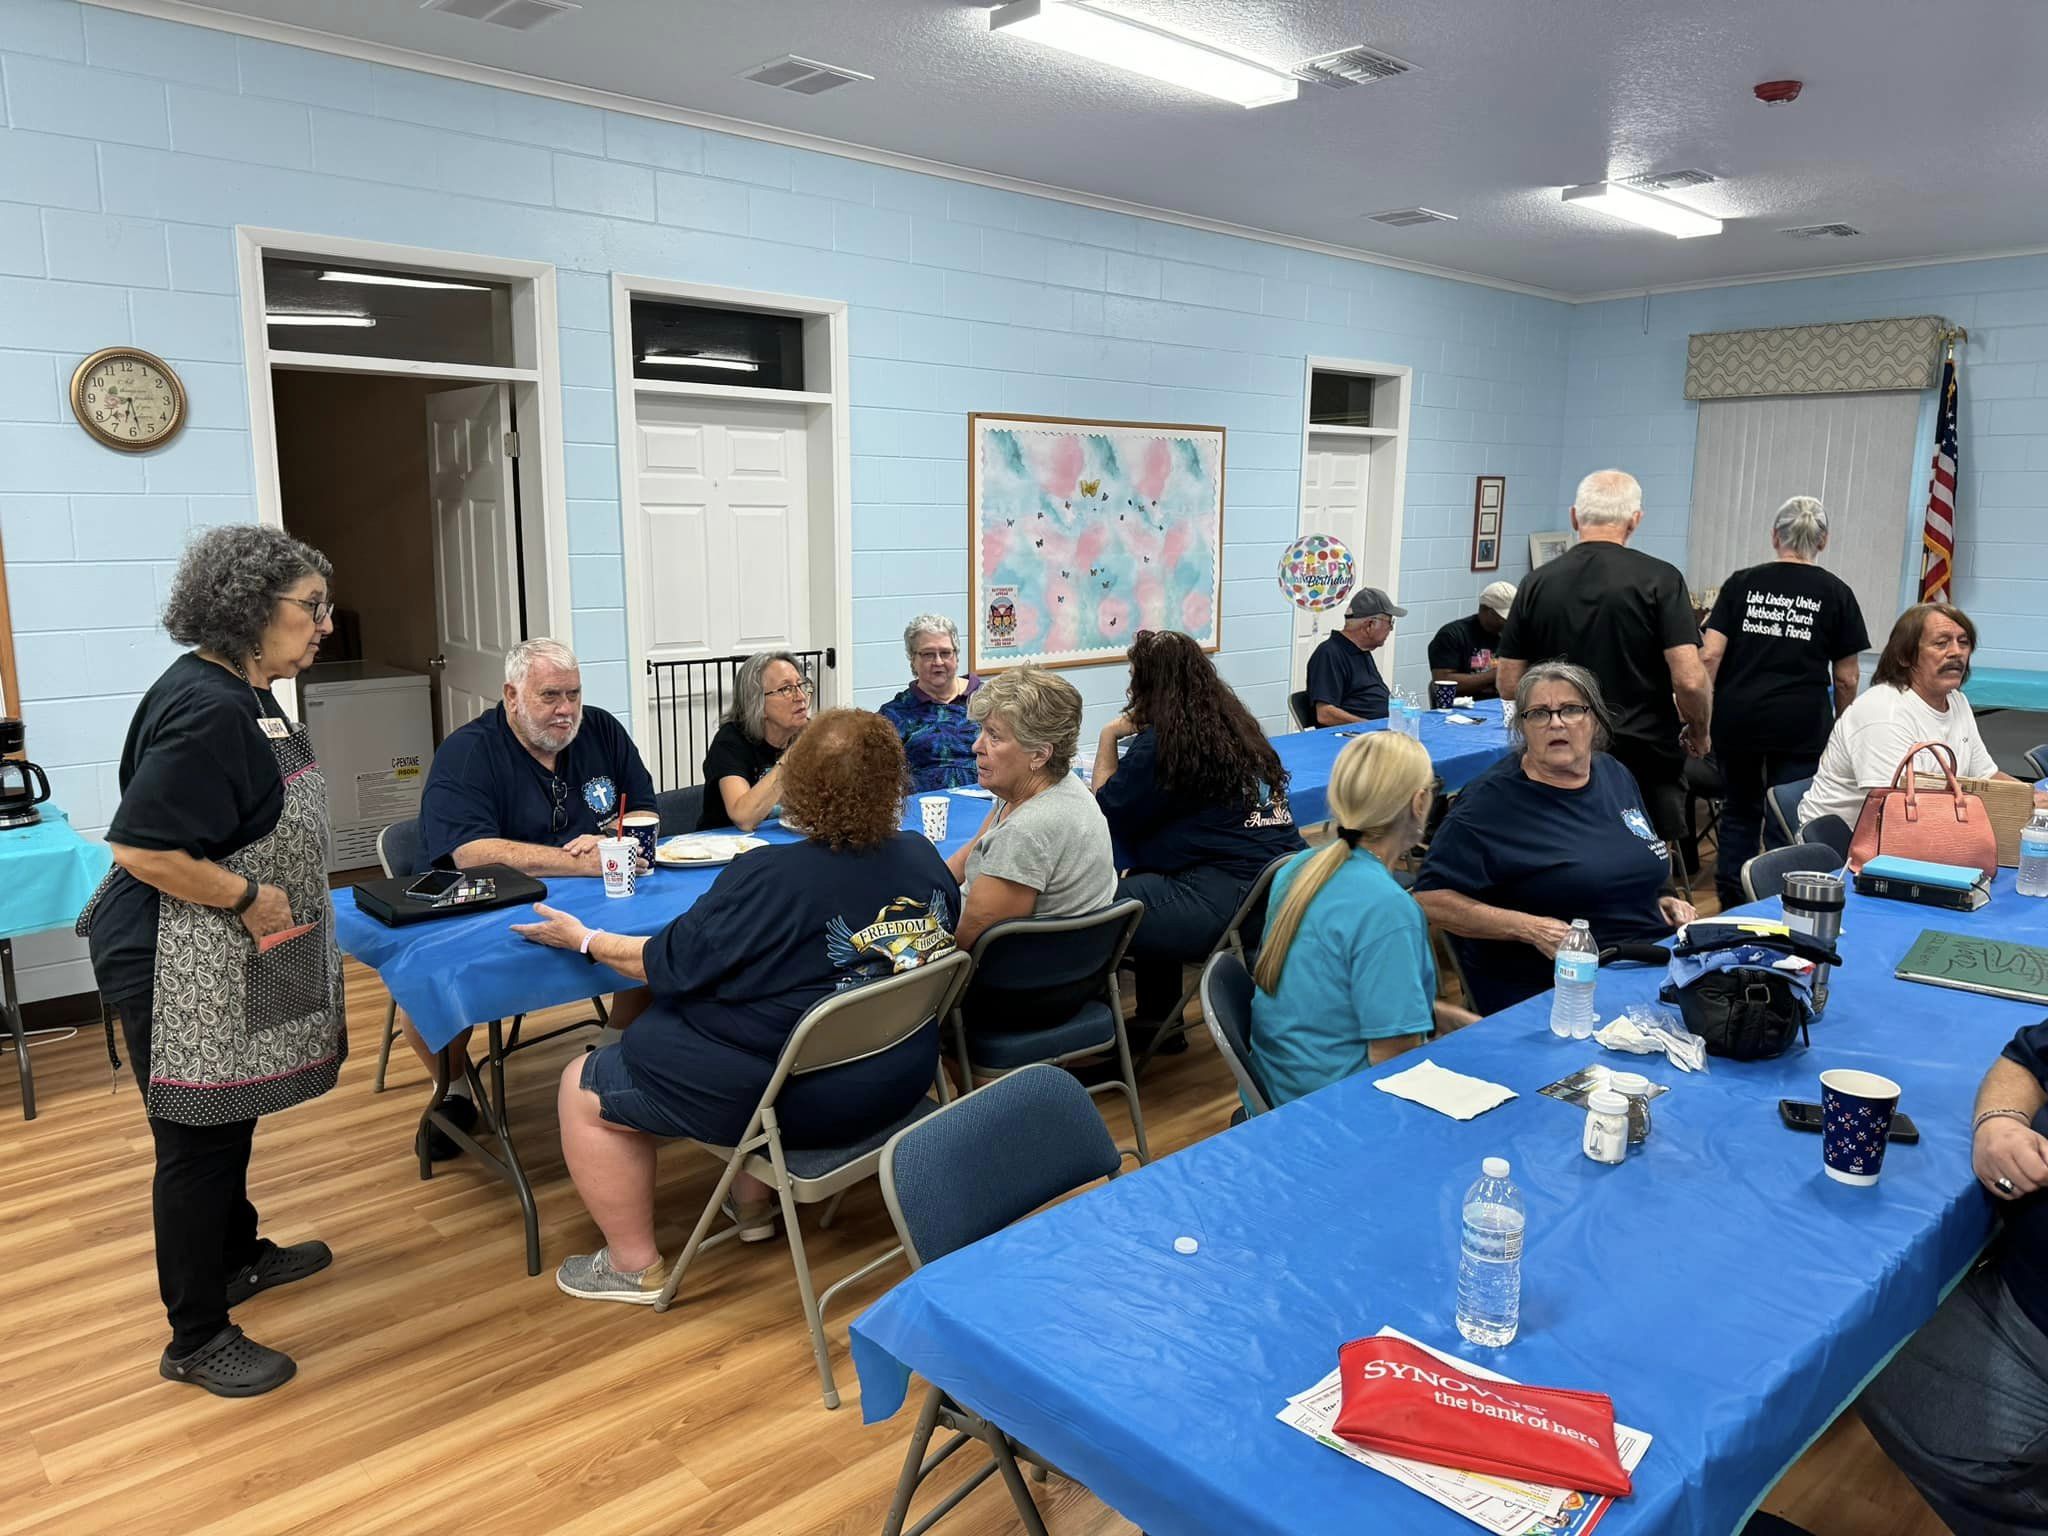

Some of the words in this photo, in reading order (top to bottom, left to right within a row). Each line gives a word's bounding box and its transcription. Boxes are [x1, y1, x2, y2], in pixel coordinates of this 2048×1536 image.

[104, 366, 115, 376] 11
[120, 362, 133, 372] 12
[142, 367, 148, 376] 1
[92, 377, 104, 387] 10
[155, 379, 163, 388] 2
[88, 393, 96, 403] 9
[163, 396, 171, 405] 3
[96, 410, 104, 420] 8
[160, 411, 166, 421] 4
[111, 423, 119, 432] 7
[129, 427, 137, 437] 6
[147, 423, 155, 433] 5
[1746, 590, 1764, 604] Lake
[1765, 592, 1795, 610] Lindsey
[1795, 595, 1822, 613] United
[1746, 604, 1785, 622] Methodist
[1786, 609, 1814, 626] Church
[1785, 624, 1812, 641] Florida
[859, 919, 926, 946] FREEDOM
[1433, 1390, 1468, 1411] the
[1472, 1399, 1525, 1425] bank
[1528, 1415, 1552, 1432] of
[1552, 1419, 1600, 1449] here
